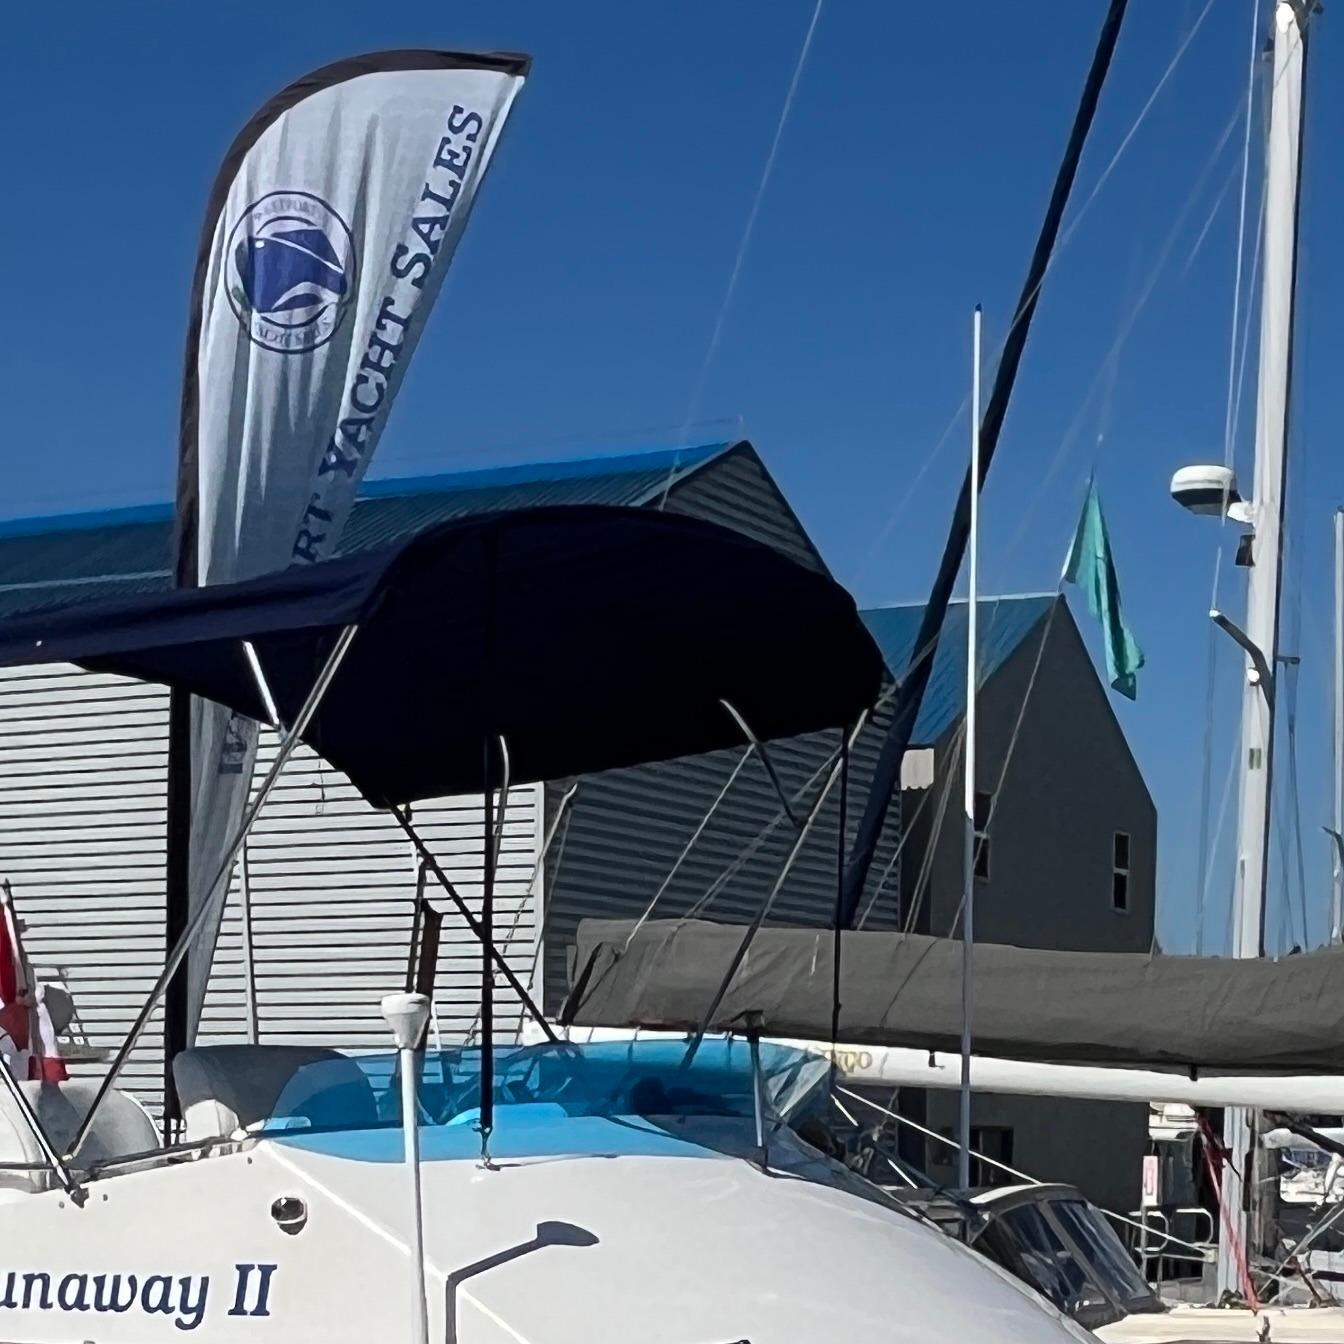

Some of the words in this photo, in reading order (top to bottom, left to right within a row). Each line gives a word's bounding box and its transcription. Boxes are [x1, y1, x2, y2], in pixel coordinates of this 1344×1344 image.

[318, 296, 411, 478] YACHT
[390, 104, 484, 290] SALES
[228, 1263, 278, 1317] II
